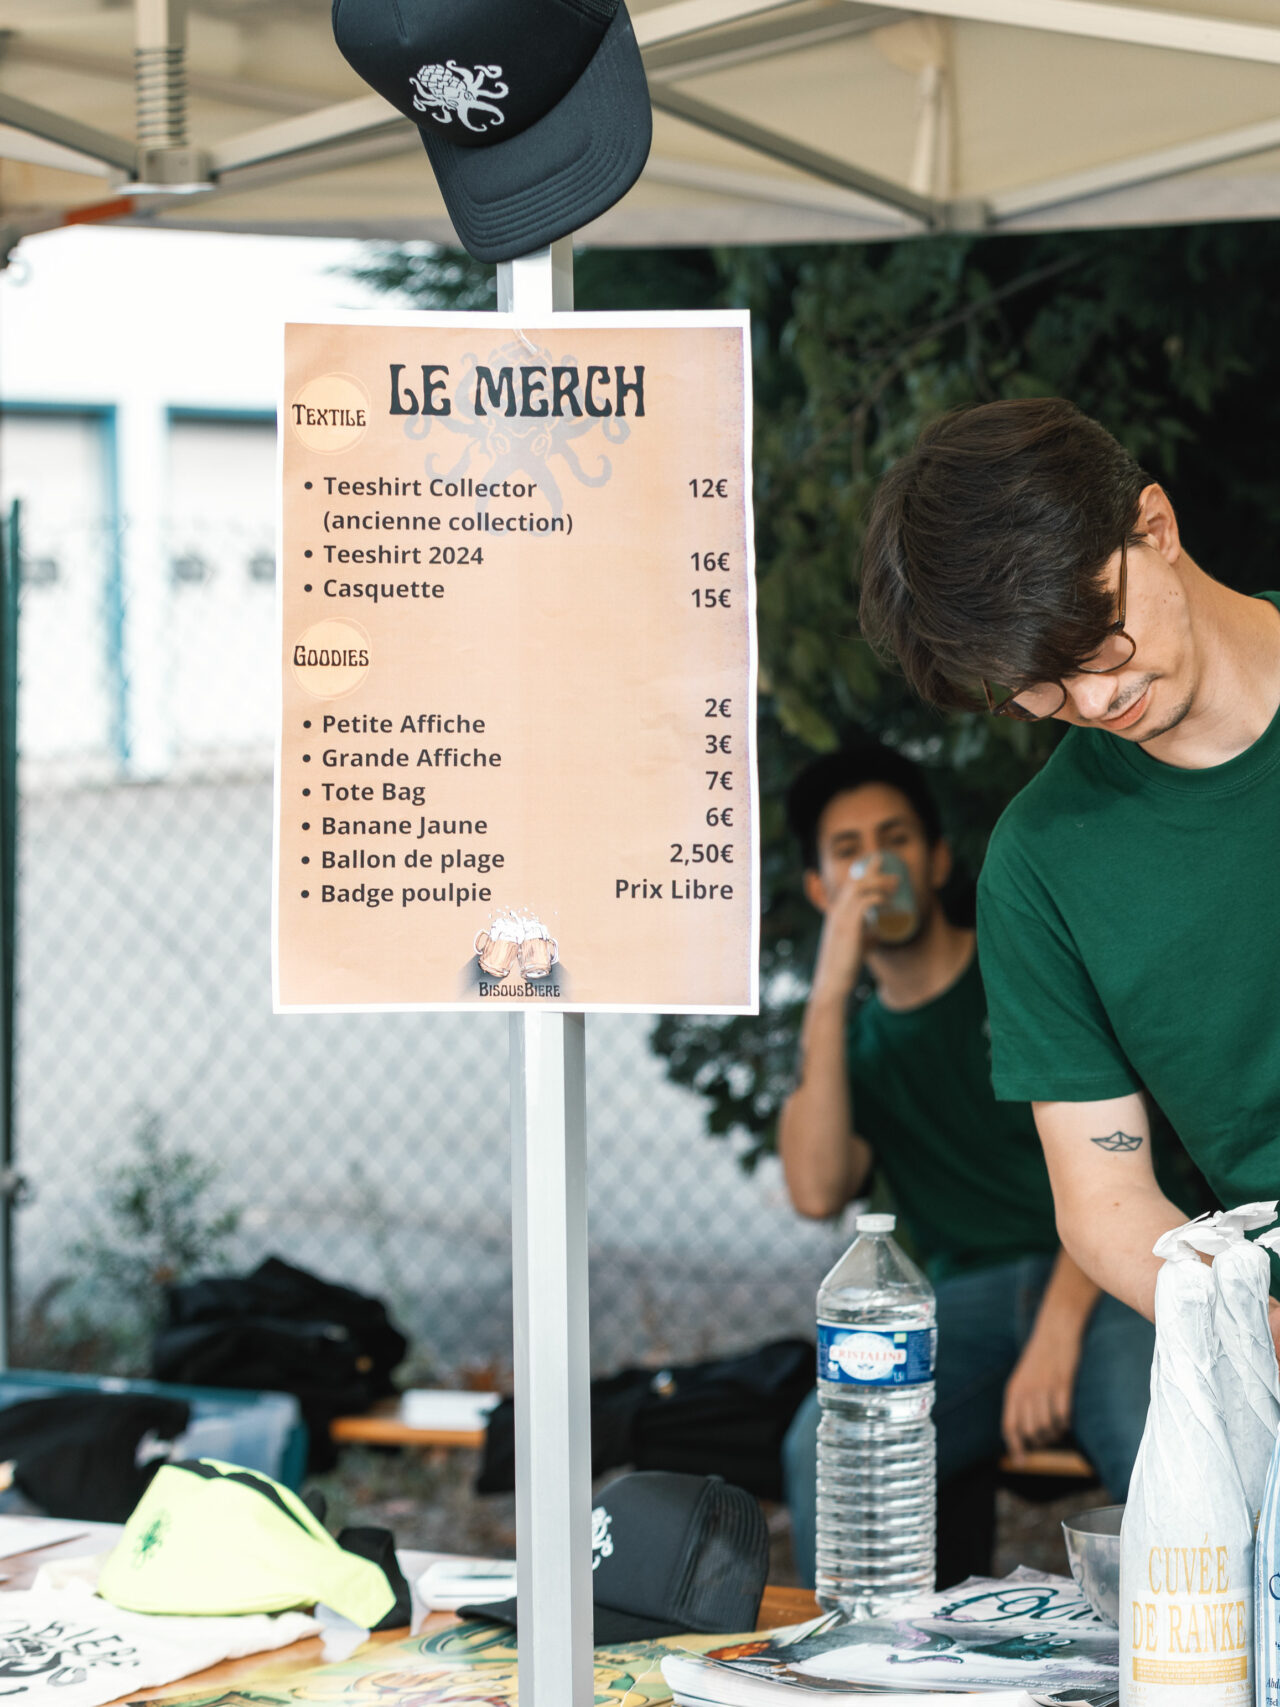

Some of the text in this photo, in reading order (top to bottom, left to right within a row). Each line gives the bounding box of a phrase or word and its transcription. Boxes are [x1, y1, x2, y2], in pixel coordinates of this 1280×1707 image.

[389, 364, 646, 418] LE MERCH
[323, 476, 537, 498] Teeshirt Collector
[689, 478, 728, 498] 12€
[323, 510, 573, 535] (ancienne collection)
[323, 545, 484, 565] Teeshirt 2024
[690, 552, 730, 572] 16€
[323, 579, 445, 604] Casquette
[691, 588, 731, 608] 15€
[704, 698, 732, 718] 2€
[323, 714, 485, 734] Petite Affiche
[705, 734, 732, 754] 3€
[322, 748, 502, 767] Grande Affiche
[705, 770, 733, 791] 7€
[321, 782, 426, 807] Tote Bag
[322, 816, 488, 839] Banane Jaune
[706, 807, 734, 827] 6€
[322, 849, 505, 874] Ballon de plage
[670, 843, 734, 866] 2,50€
[321, 882, 492, 908] Badge poulpie
[616, 878, 733, 900] Prix Libre
[1148, 1533, 1230, 1595] CUVÉE
[1132, 1600, 1157, 1652] DE
[1168, 1600, 1247, 1653] RANKE
